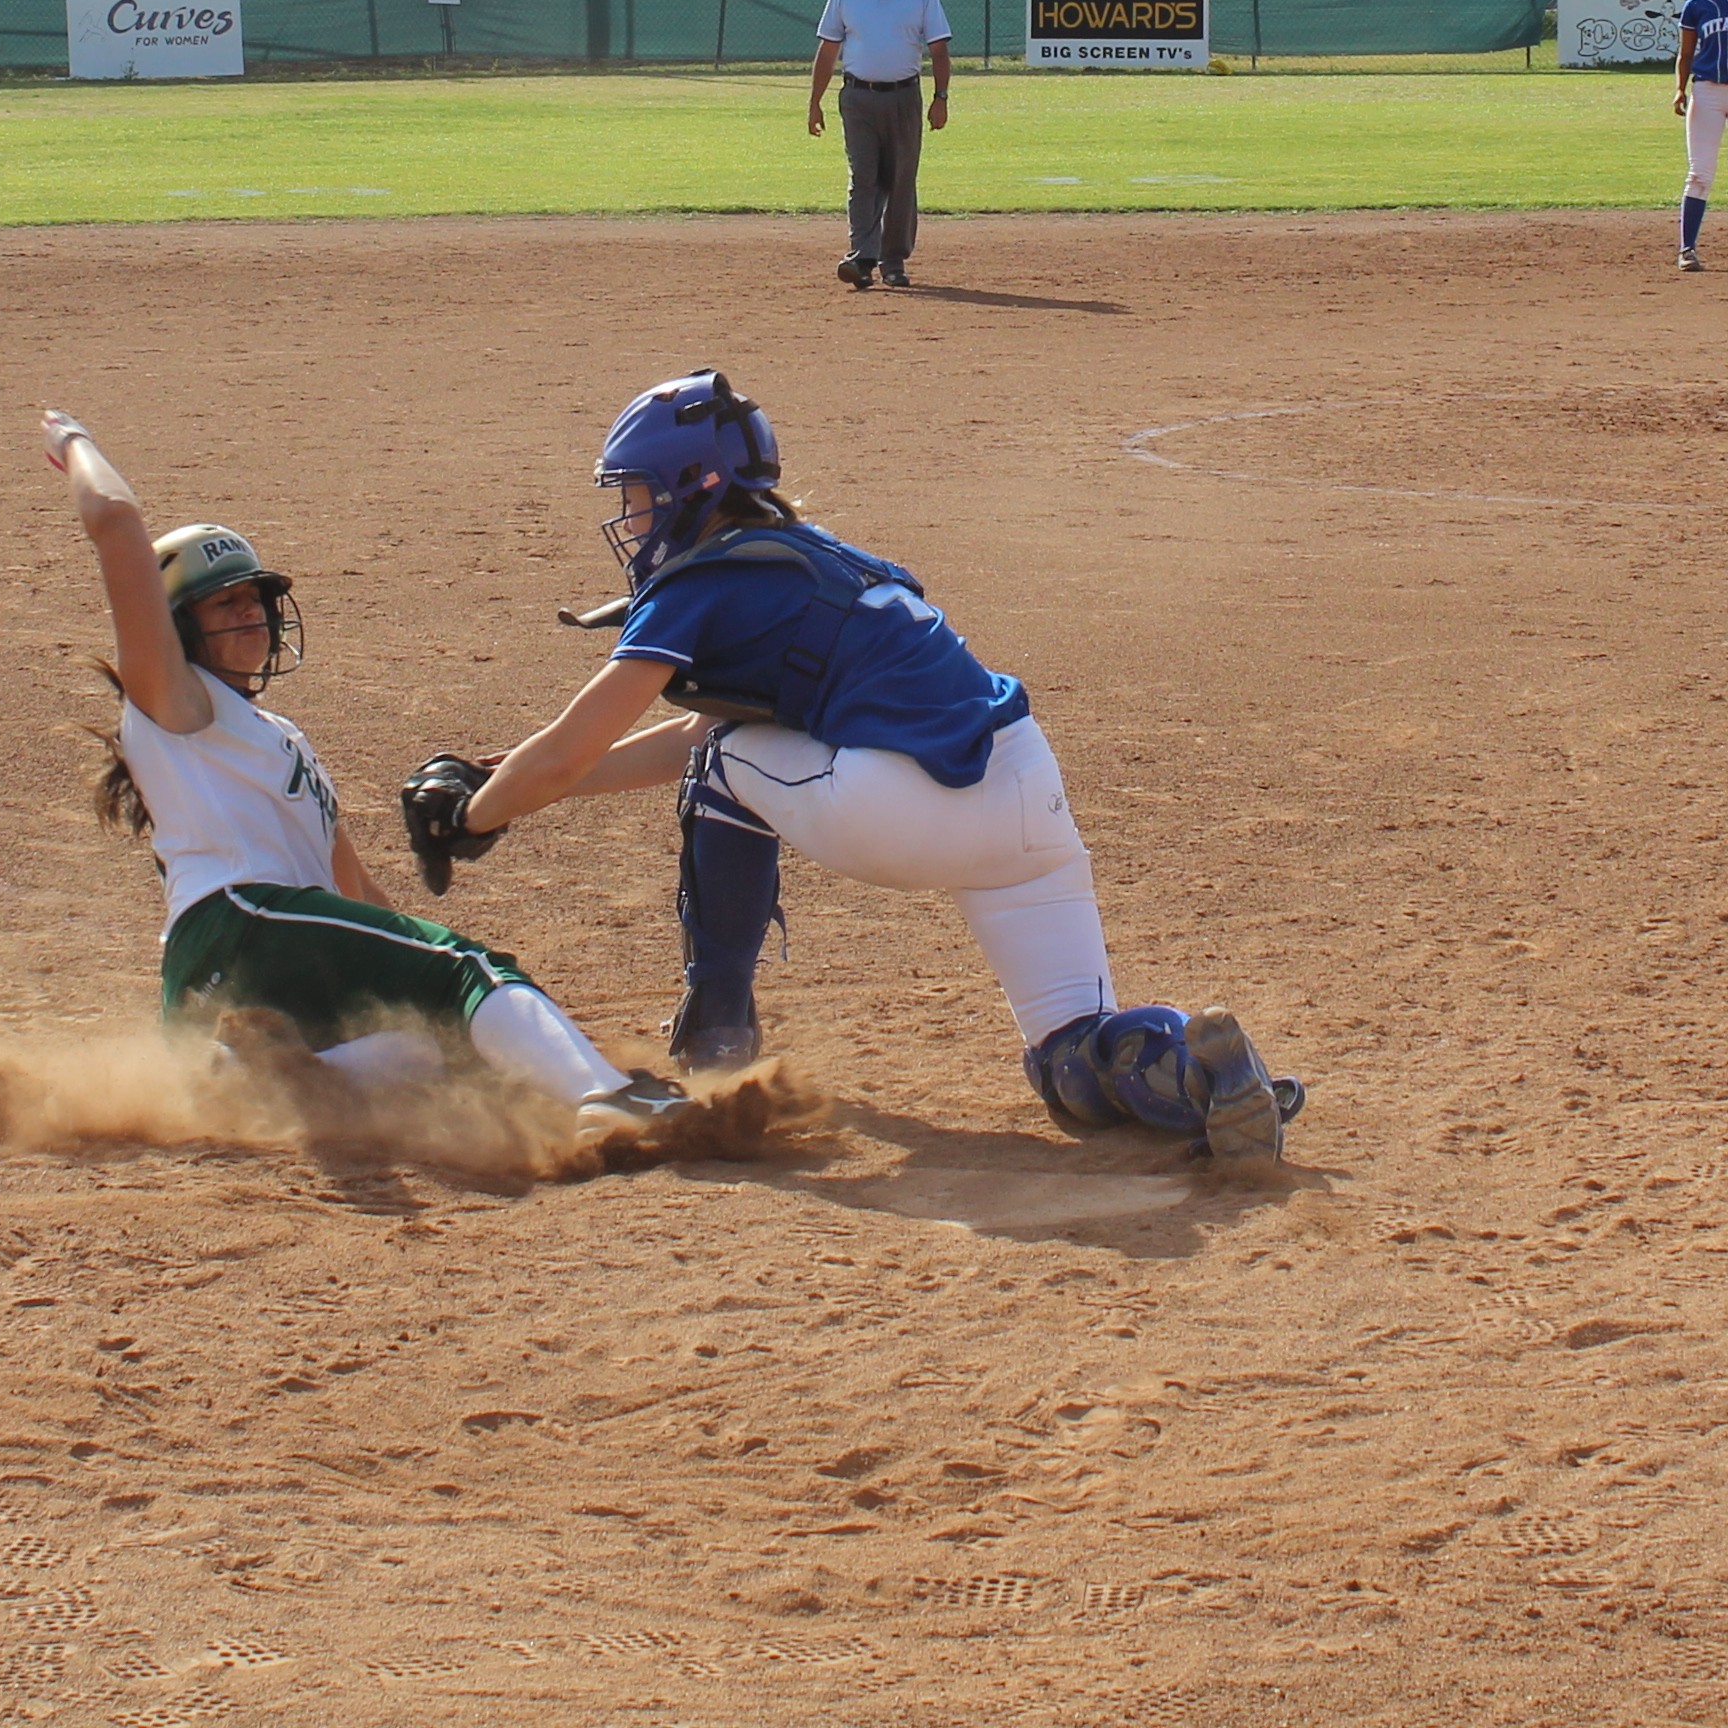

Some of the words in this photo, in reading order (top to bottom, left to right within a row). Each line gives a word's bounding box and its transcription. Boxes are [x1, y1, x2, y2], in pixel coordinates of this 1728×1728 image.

[1039, 2, 1196, 29] HOWARD'S
[136, 38, 158, 46] FOR
[165, 36, 209, 46] WOMEN
[1041, 47, 1071, 58] BIG
[1078, 47, 1150, 59] SCREEN
[1157, 47, 1192, 59] TV's
[202, 537, 251, 564] RAM
